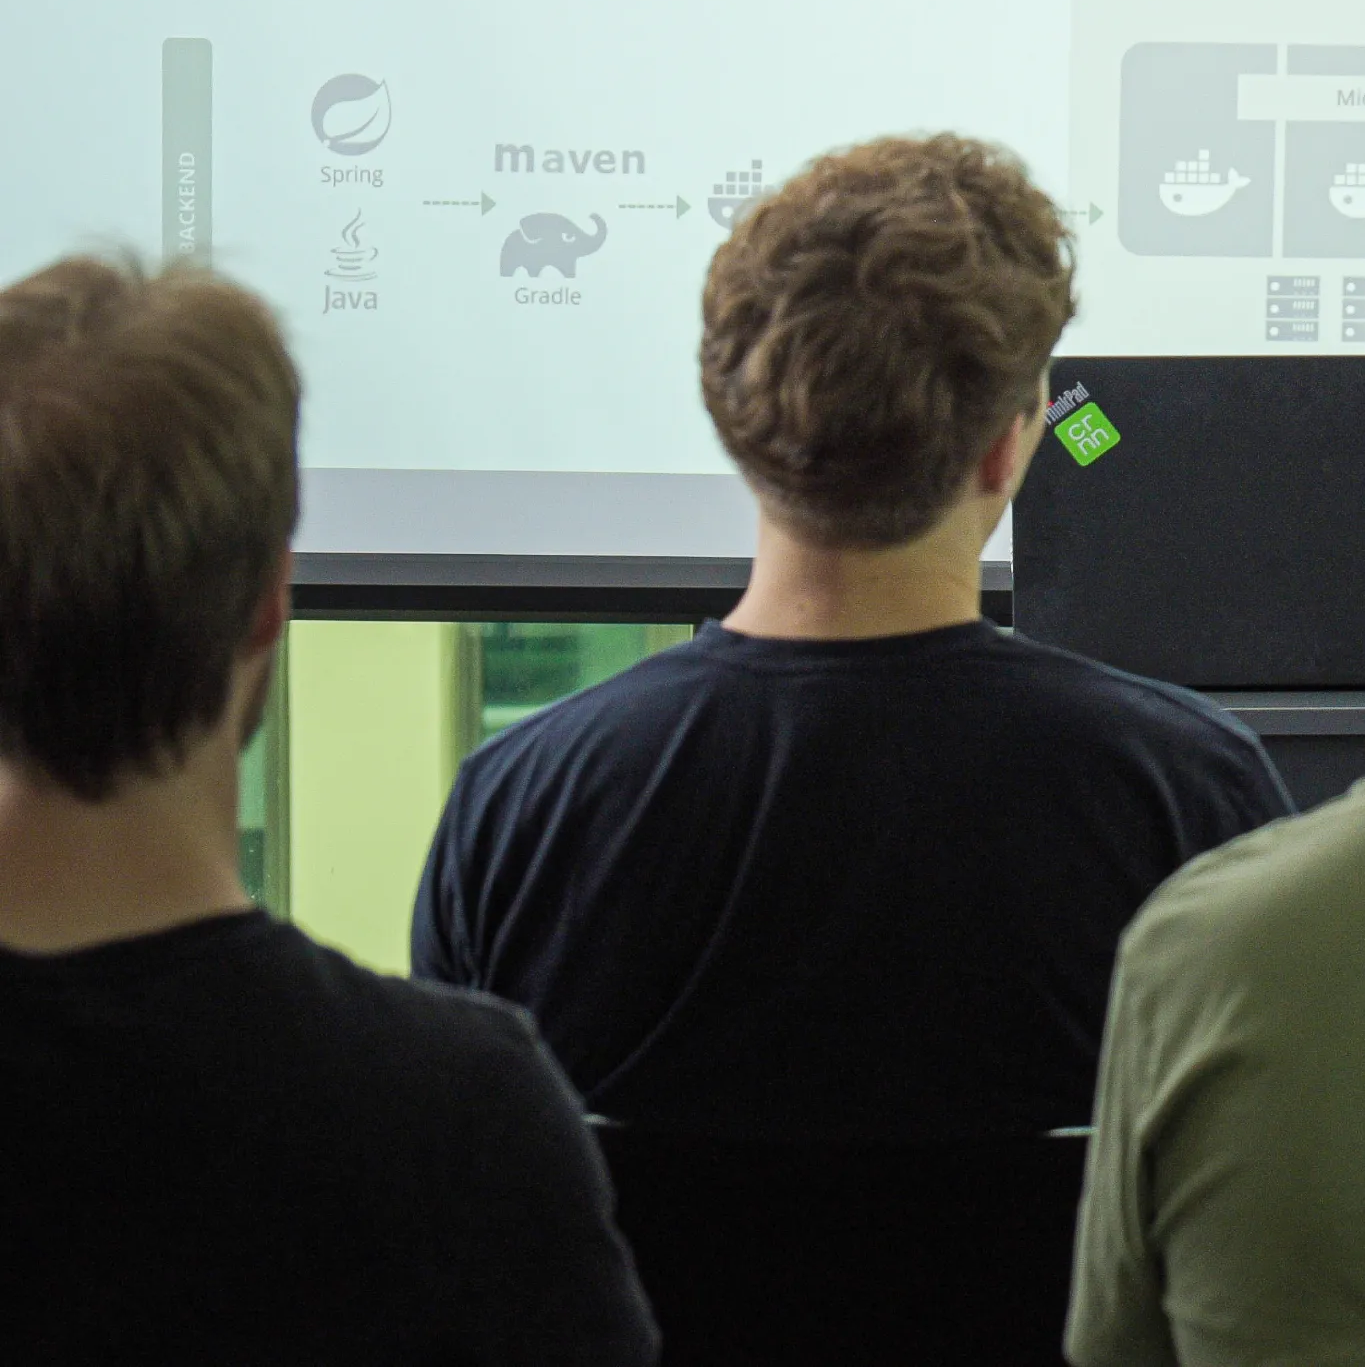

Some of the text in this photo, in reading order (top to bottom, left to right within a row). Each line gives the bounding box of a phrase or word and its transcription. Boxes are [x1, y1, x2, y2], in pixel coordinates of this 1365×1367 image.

[495, 144, 644, 174] maven
[321, 166, 383, 188] Spring
[323, 285, 377, 314] Java
[515, 287, 581, 305] Gradle
